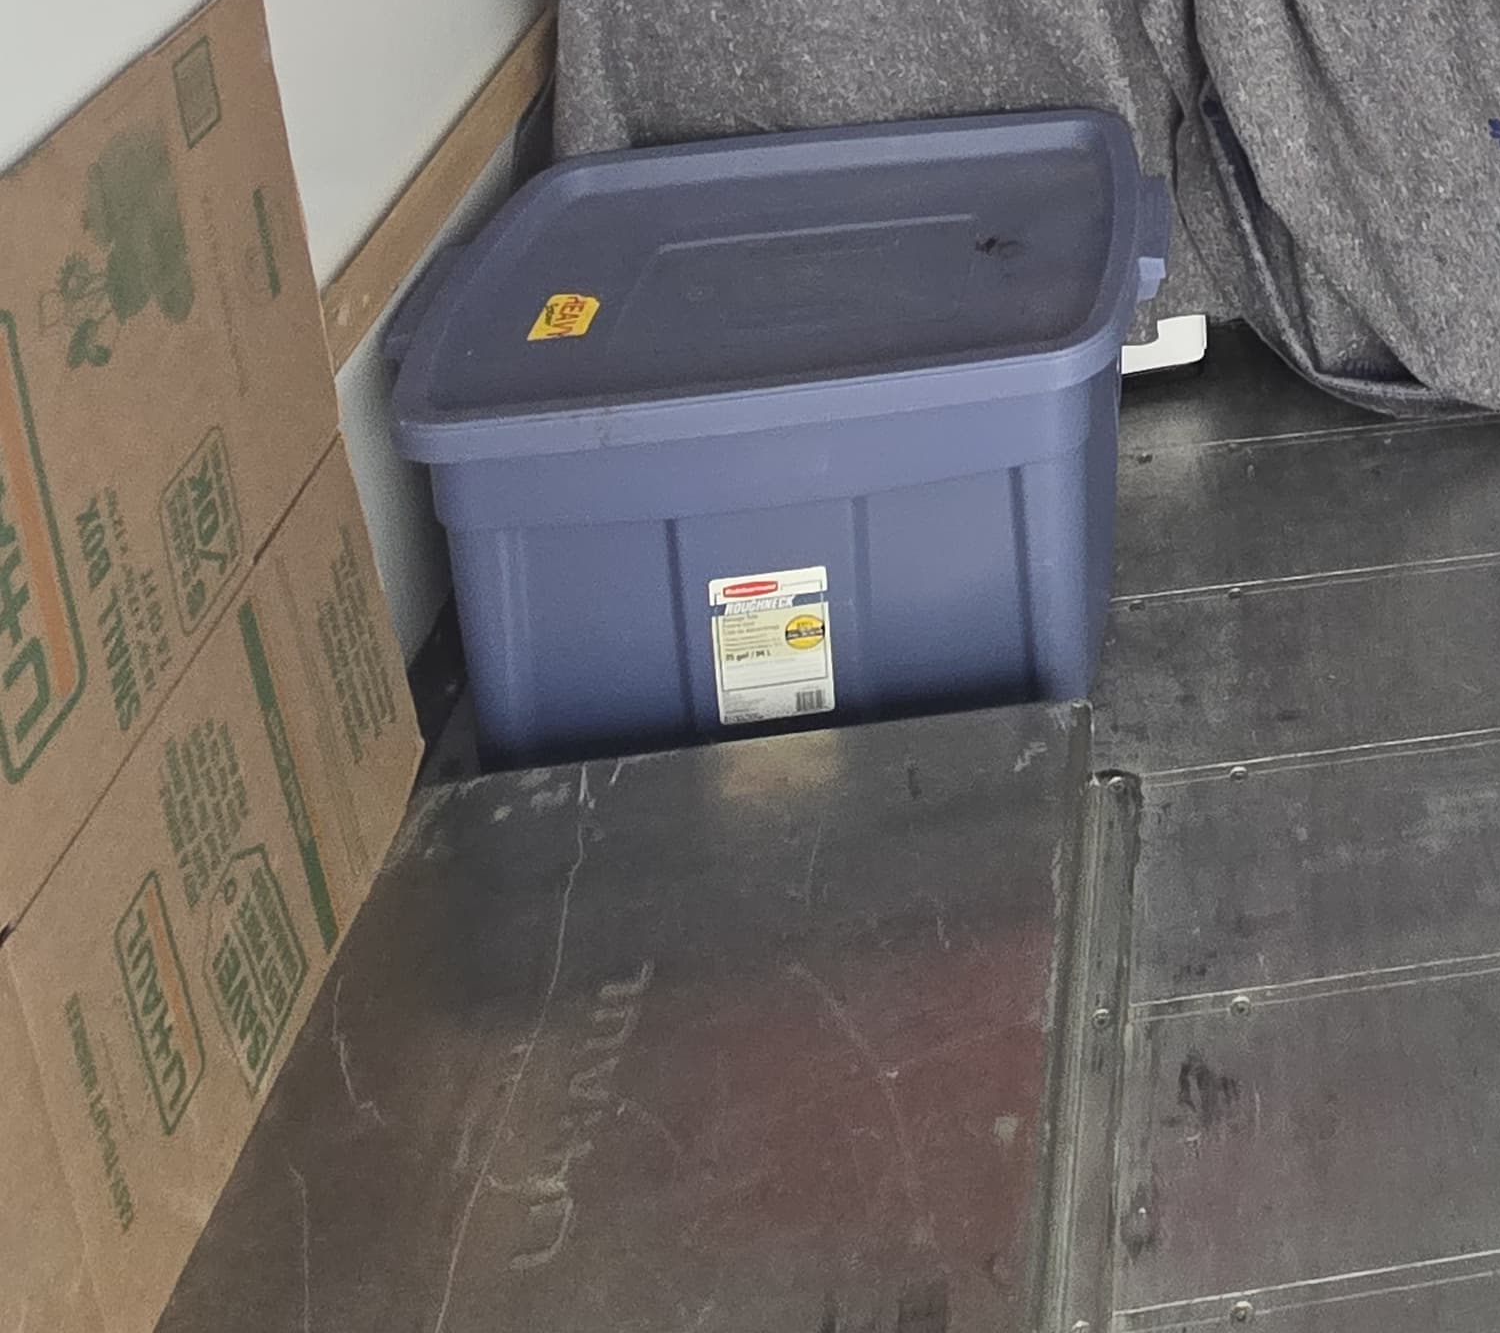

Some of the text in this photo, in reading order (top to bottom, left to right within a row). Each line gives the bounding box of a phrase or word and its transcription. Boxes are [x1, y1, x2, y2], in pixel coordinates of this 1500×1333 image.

[76, 496, 111, 590] BOX
[98, 585, 141, 733] SMALL
[724, 595, 795, 615] ROUGHNECK
[126, 907, 188, 1113] U-HAUL
